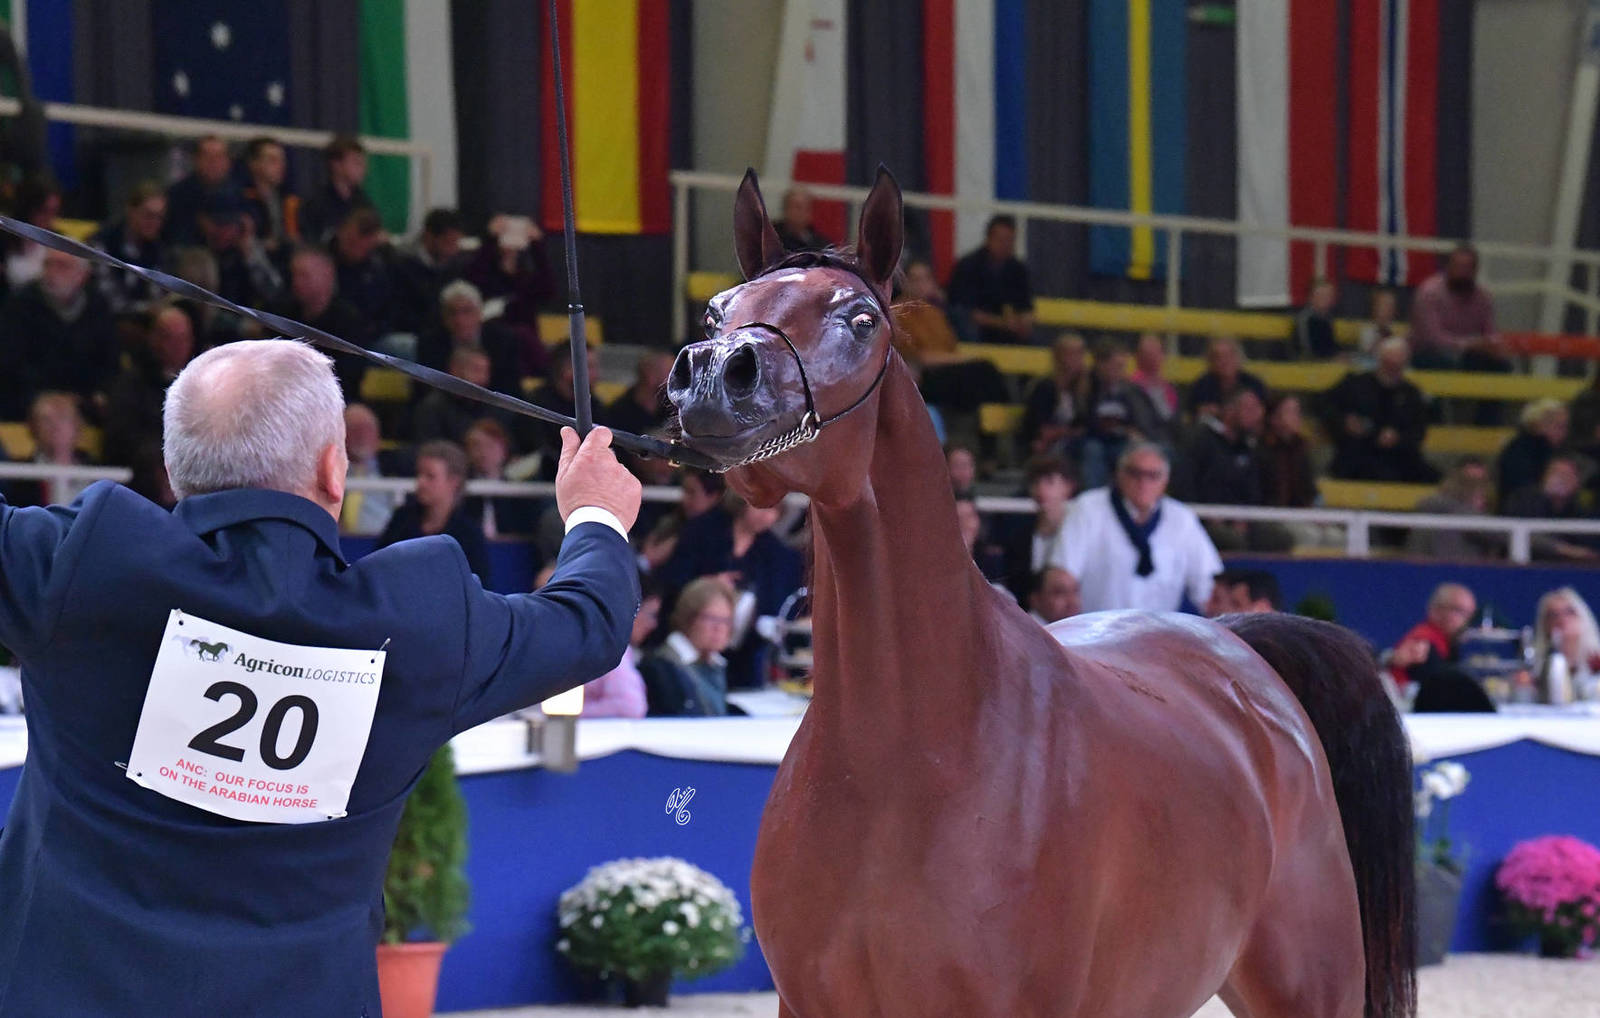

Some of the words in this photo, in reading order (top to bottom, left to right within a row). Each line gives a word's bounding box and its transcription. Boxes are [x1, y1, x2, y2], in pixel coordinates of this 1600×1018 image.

[187, 680, 319, 770] 20
[159, 766, 179, 780] ON
[182, 774, 207, 791] THE
[209, 784, 271, 806] ARABIAN
[273, 798, 318, 808] HORSE
[176, 758, 208, 777] ANC:
[215, 772, 244, 786] OUR
[248, 778, 293, 793] FOCUS
[296, 784, 308, 794] IS
